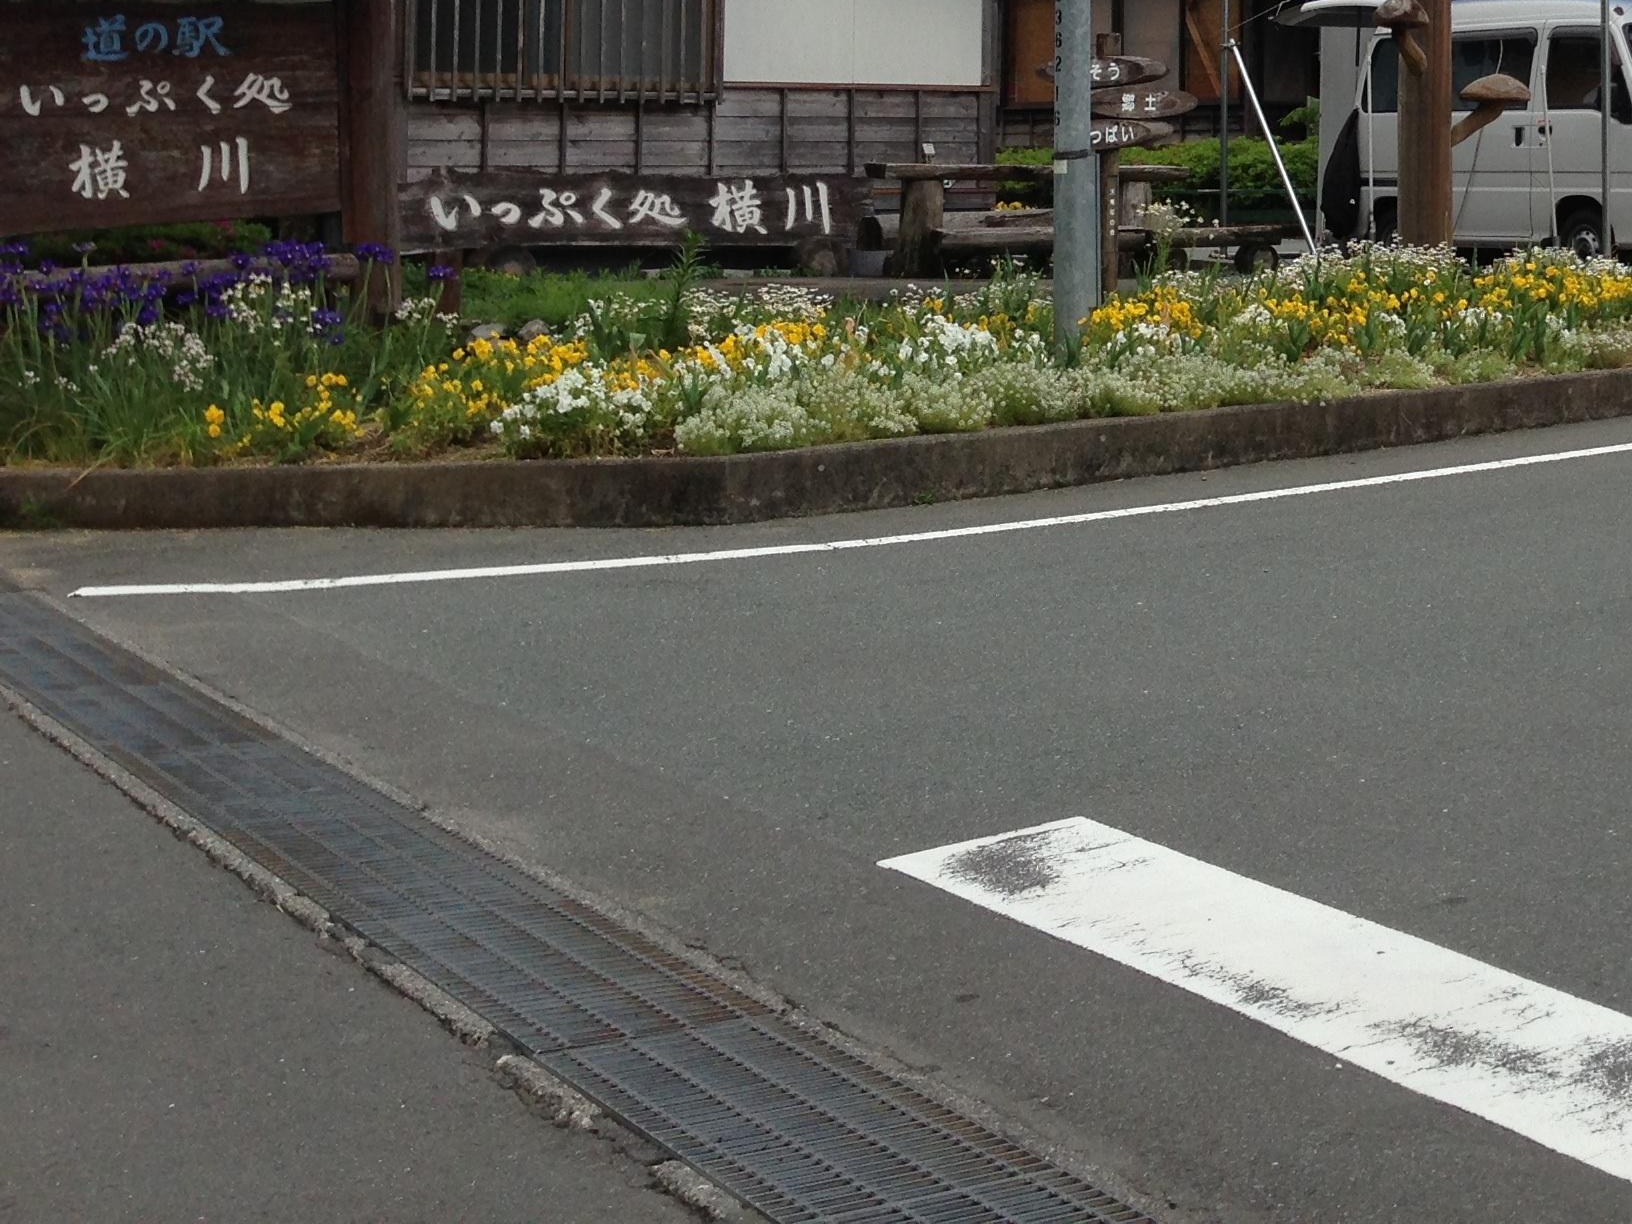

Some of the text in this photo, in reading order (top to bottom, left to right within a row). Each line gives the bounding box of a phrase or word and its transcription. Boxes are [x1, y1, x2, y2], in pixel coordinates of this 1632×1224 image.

[82, 14, 231, 62] 道の駅
[19, 72, 291, 117] いっぷく処
[430, 187, 688, 230] いっぷく処
